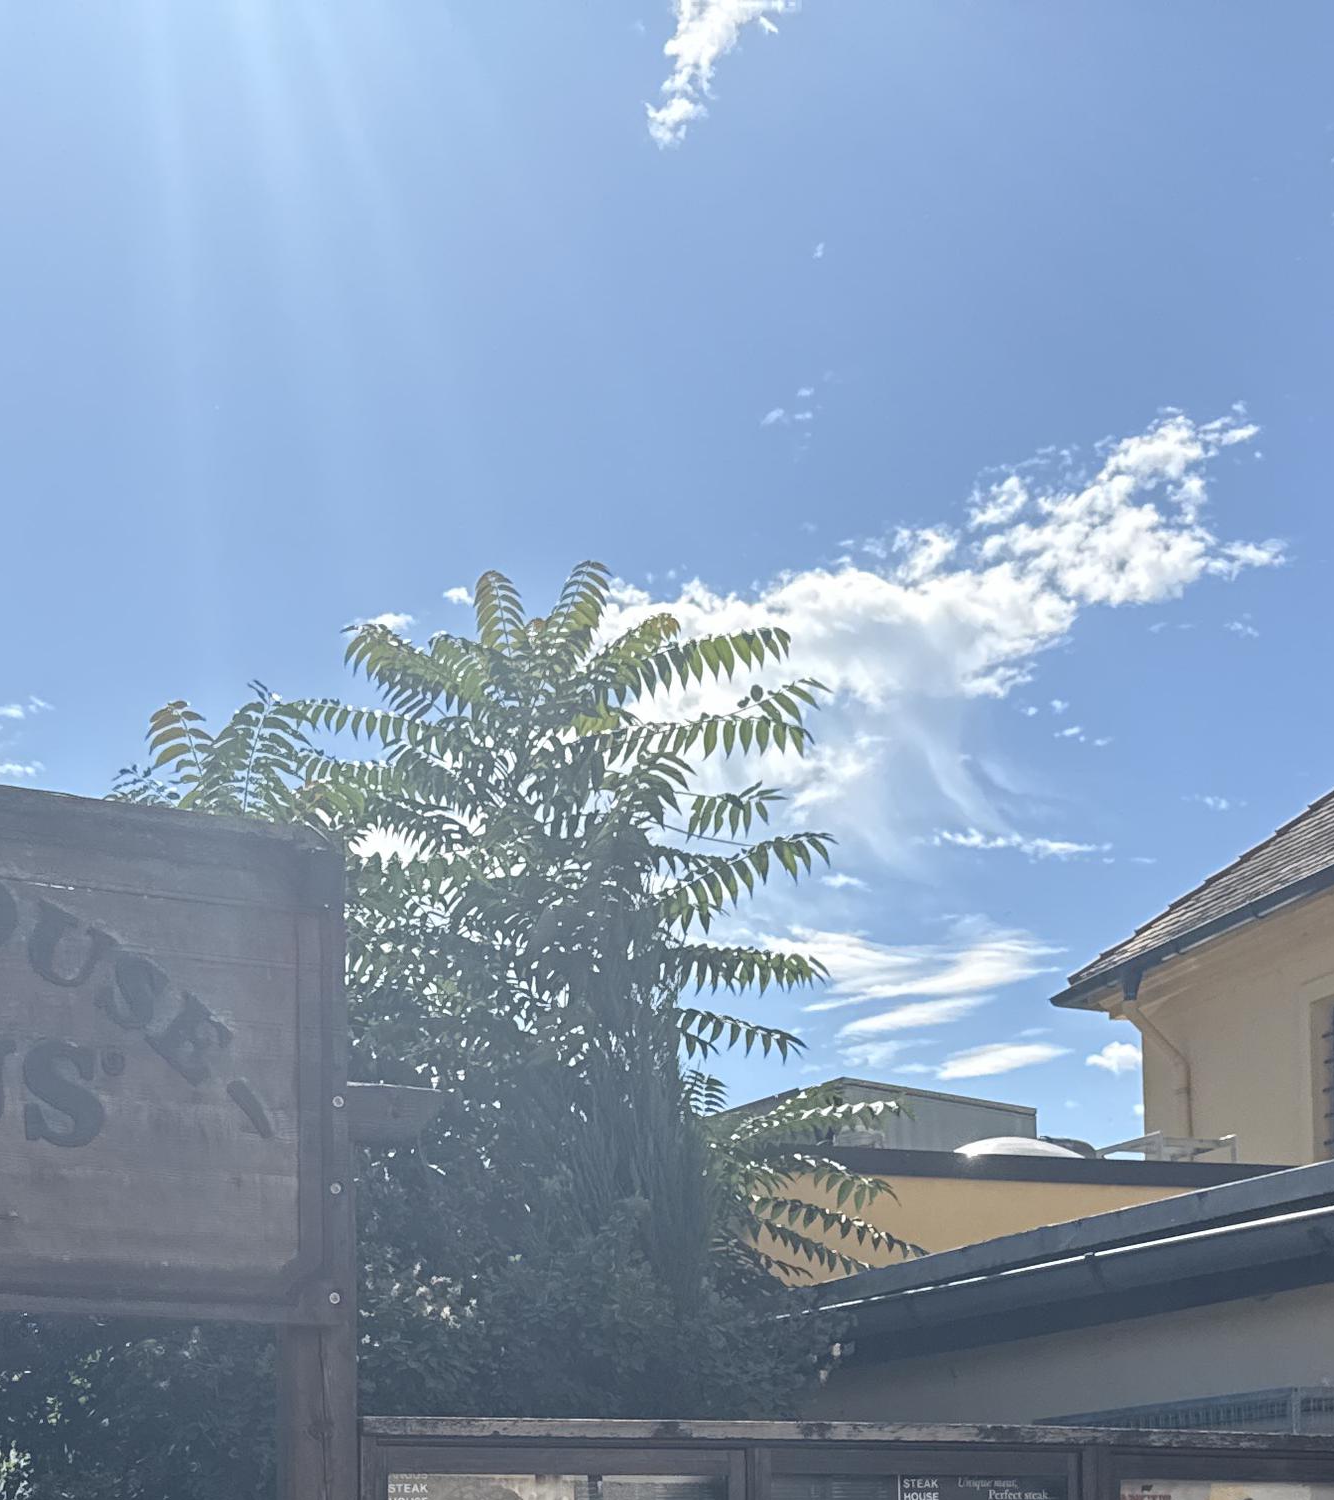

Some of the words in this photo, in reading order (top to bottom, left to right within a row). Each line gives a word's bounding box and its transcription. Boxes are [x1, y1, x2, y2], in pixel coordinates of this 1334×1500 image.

[388, 1483, 428, 1493] STEAK
[903, 1479, 939, 1489] STEAK
[988, 1489, 1022, 1500] Perfect
